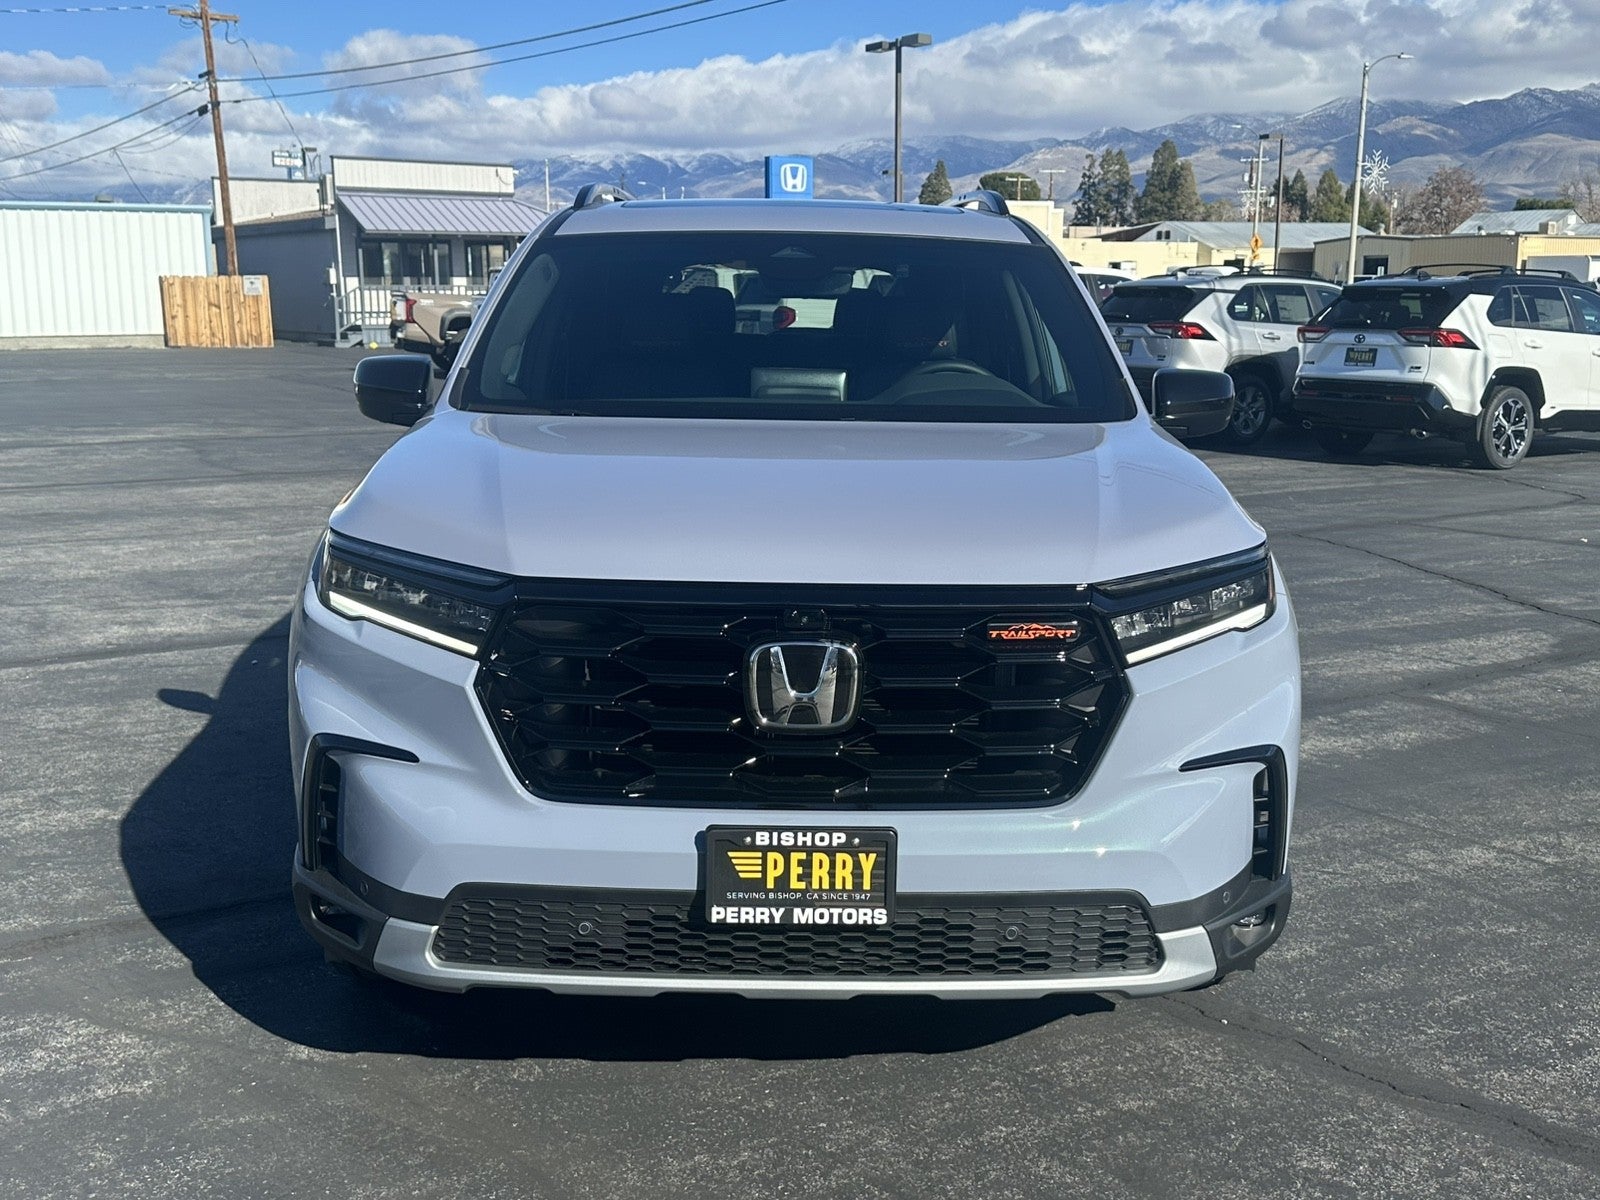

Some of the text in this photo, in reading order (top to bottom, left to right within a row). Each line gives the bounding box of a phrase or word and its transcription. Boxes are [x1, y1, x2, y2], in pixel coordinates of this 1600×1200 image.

[989, 630, 1076, 640] TRAILSPORT
[755, 831, 847, 847] BISHOP
[766, 851, 877, 890] PERRY
[806, 892, 819, 900] CA
[822, 892, 848, 900] SINCE
[851, 893, 871, 901] 1947
[711, 906, 887, 925] PERRY MOTORS
